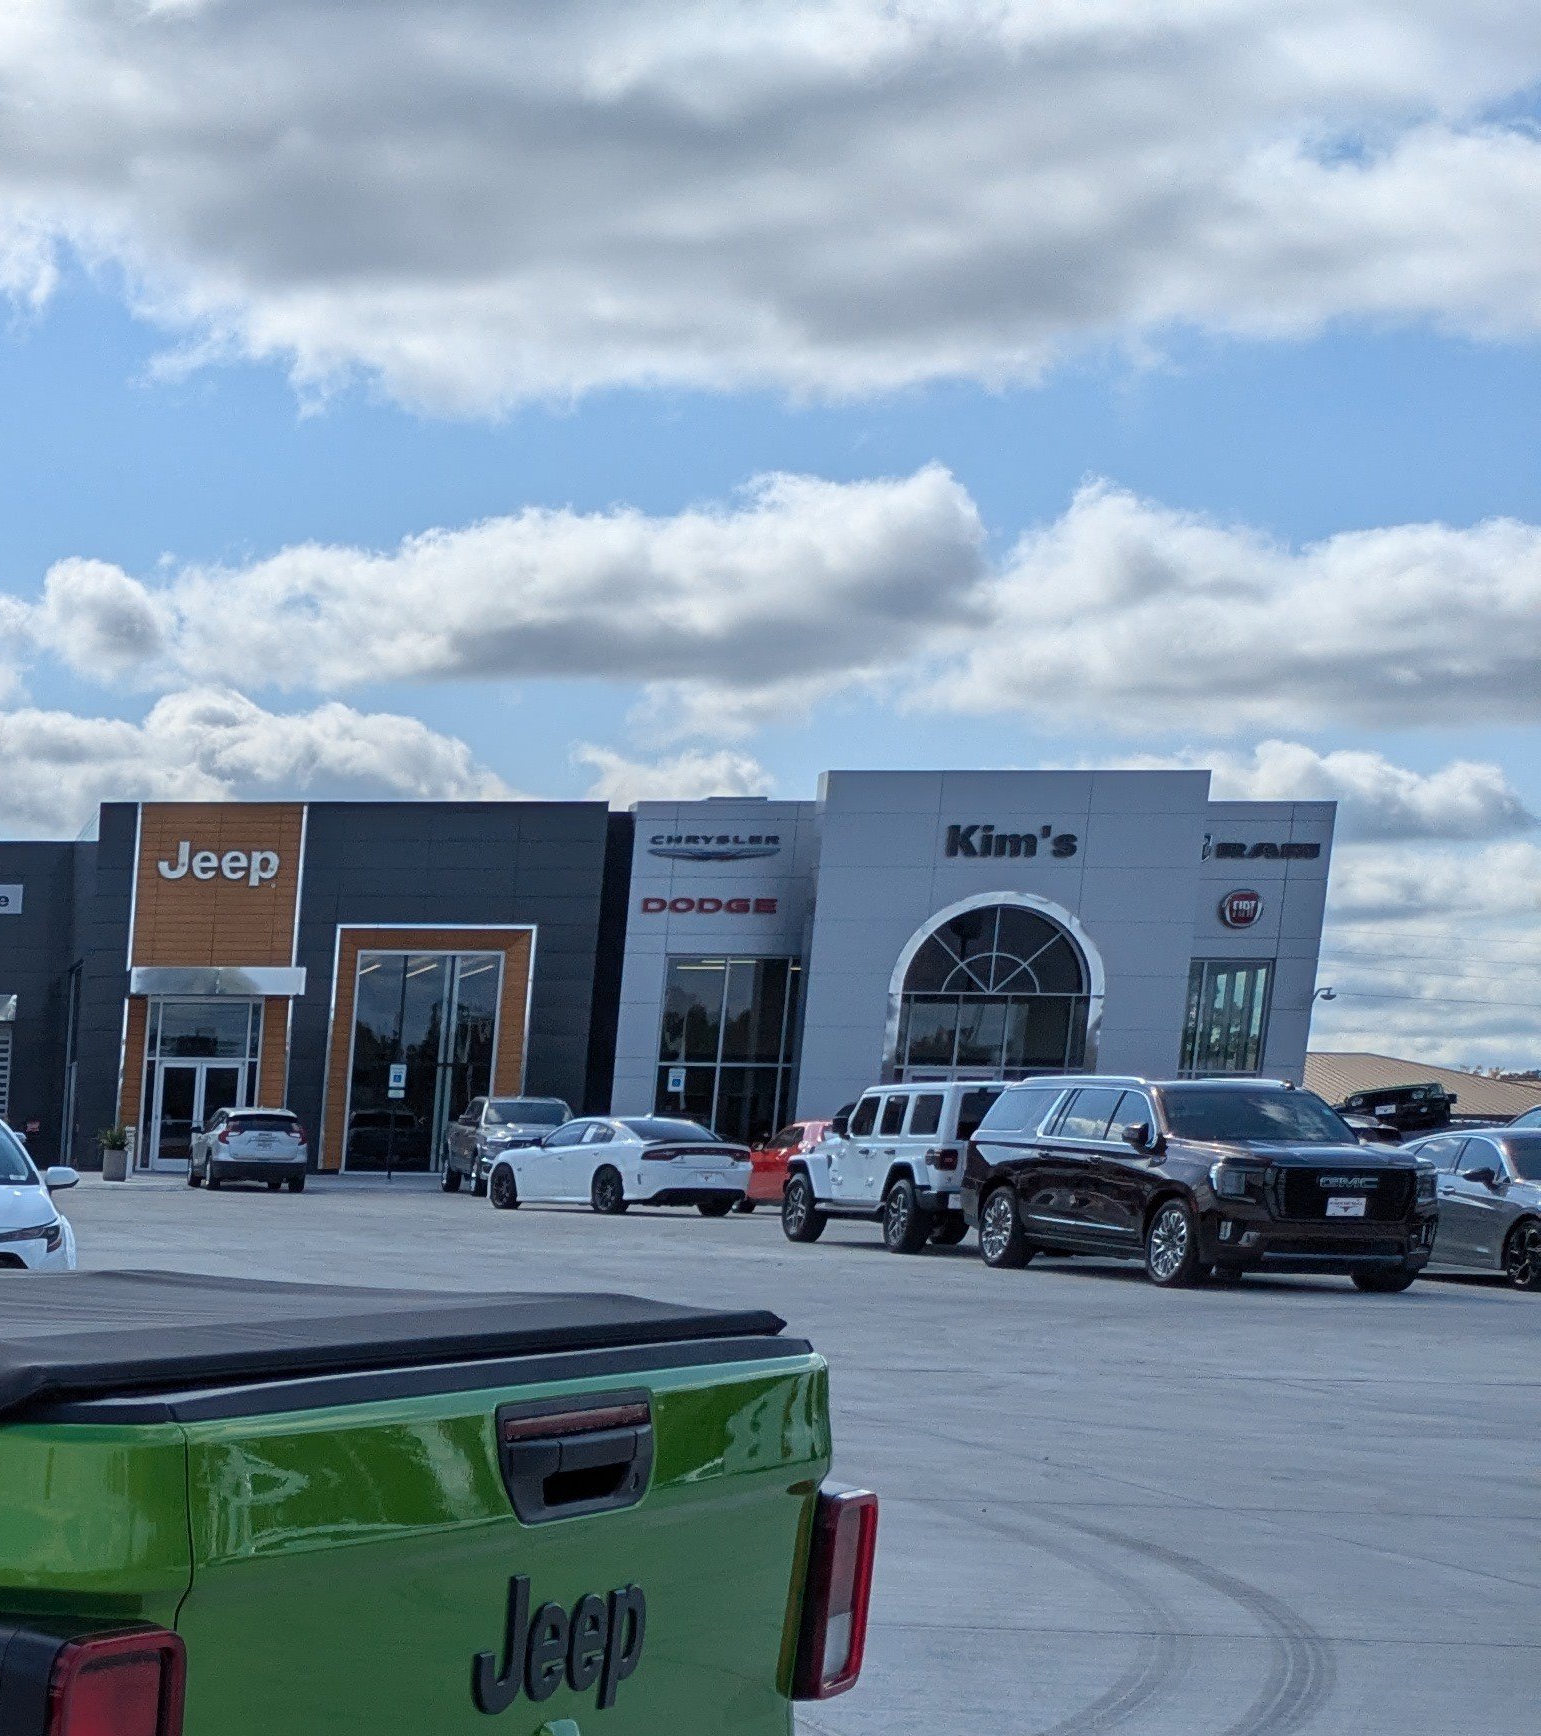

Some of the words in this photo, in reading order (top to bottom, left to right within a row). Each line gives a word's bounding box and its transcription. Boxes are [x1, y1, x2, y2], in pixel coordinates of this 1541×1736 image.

[650, 835, 781, 845] CHRYSLER
[946, 824, 1078, 858] Kim's
[1215, 842, 1321, 860] RAM
[158, 840, 280, 887] Jeep
[642, 897, 779, 914] DODGE
[1319, 1176, 1379, 1189] GMC
[472, 1573, 647, 1715] Jeep
